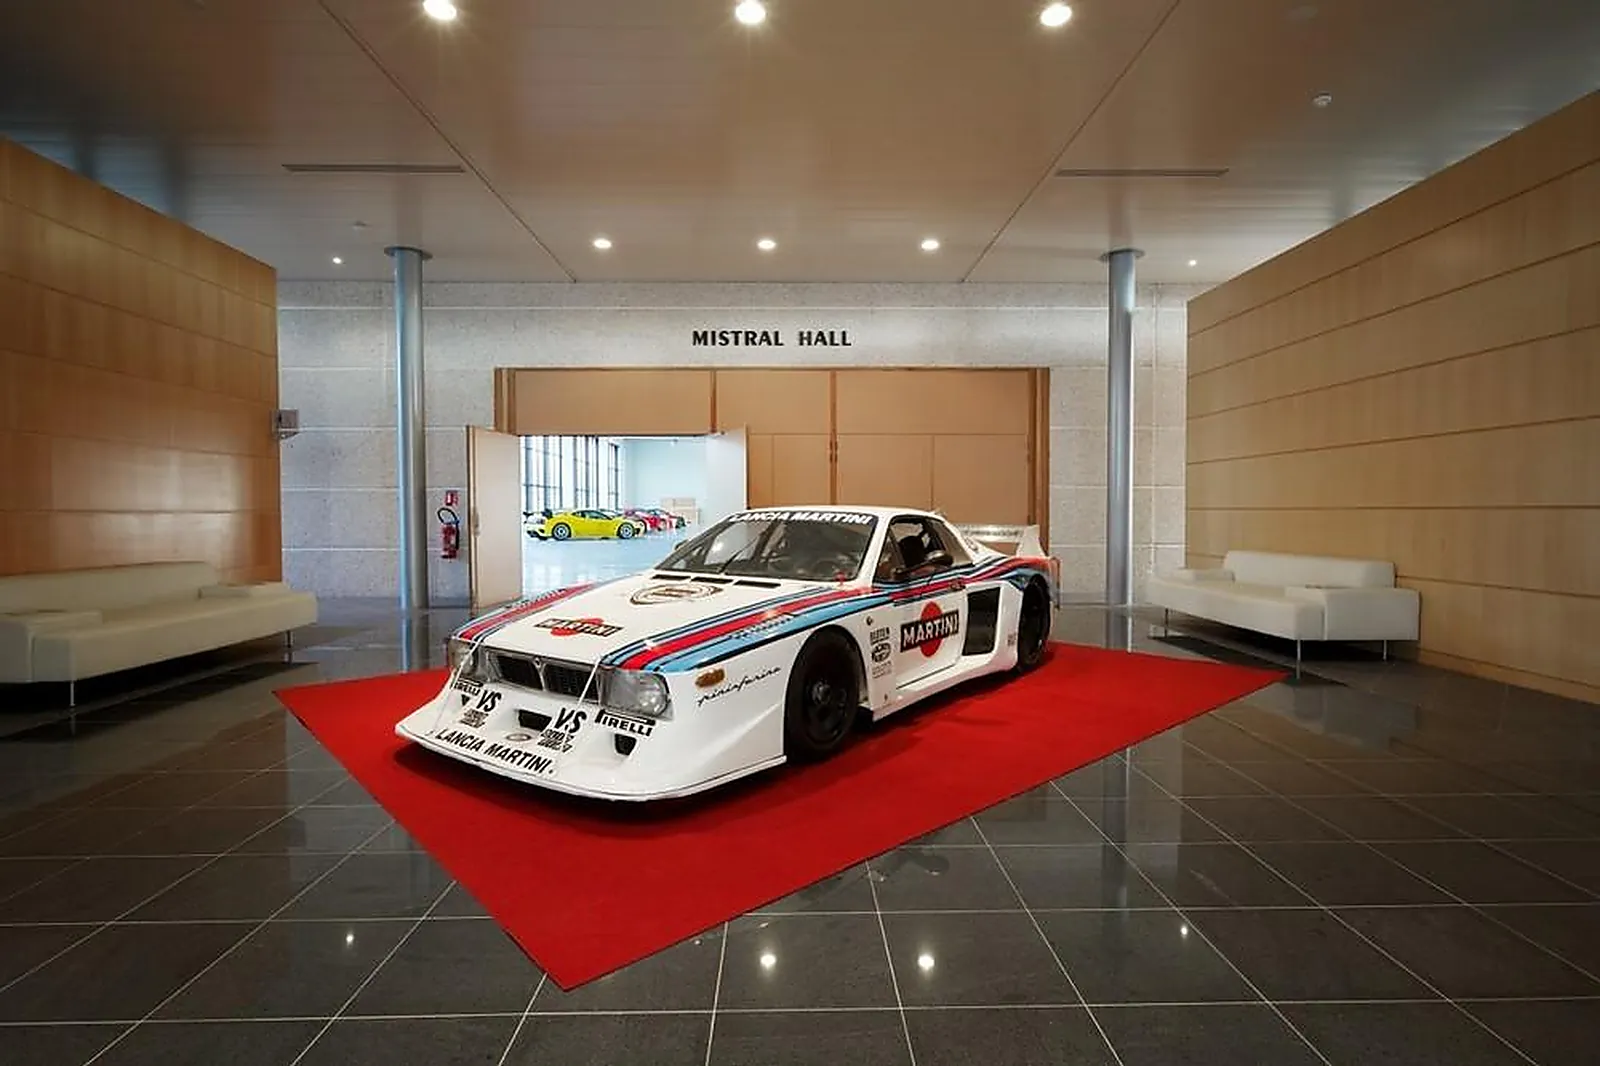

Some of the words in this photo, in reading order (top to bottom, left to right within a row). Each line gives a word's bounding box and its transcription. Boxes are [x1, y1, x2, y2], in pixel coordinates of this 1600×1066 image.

[692, 330, 785, 347] MISTRAL
[799, 330, 852, 347] HALL
[729, 511, 790, 523] LANCIA
[791, 512, 874, 525] MARTINI
[536, 618, 622, 638] MARTINI
[901, 613, 959, 649] MARTINI
[476, 690, 502, 712] VS
[554, 707, 587, 733] VS
[435, 728, 486, 753] LANCIA
[485, 743, 553, 774] MARTINI
